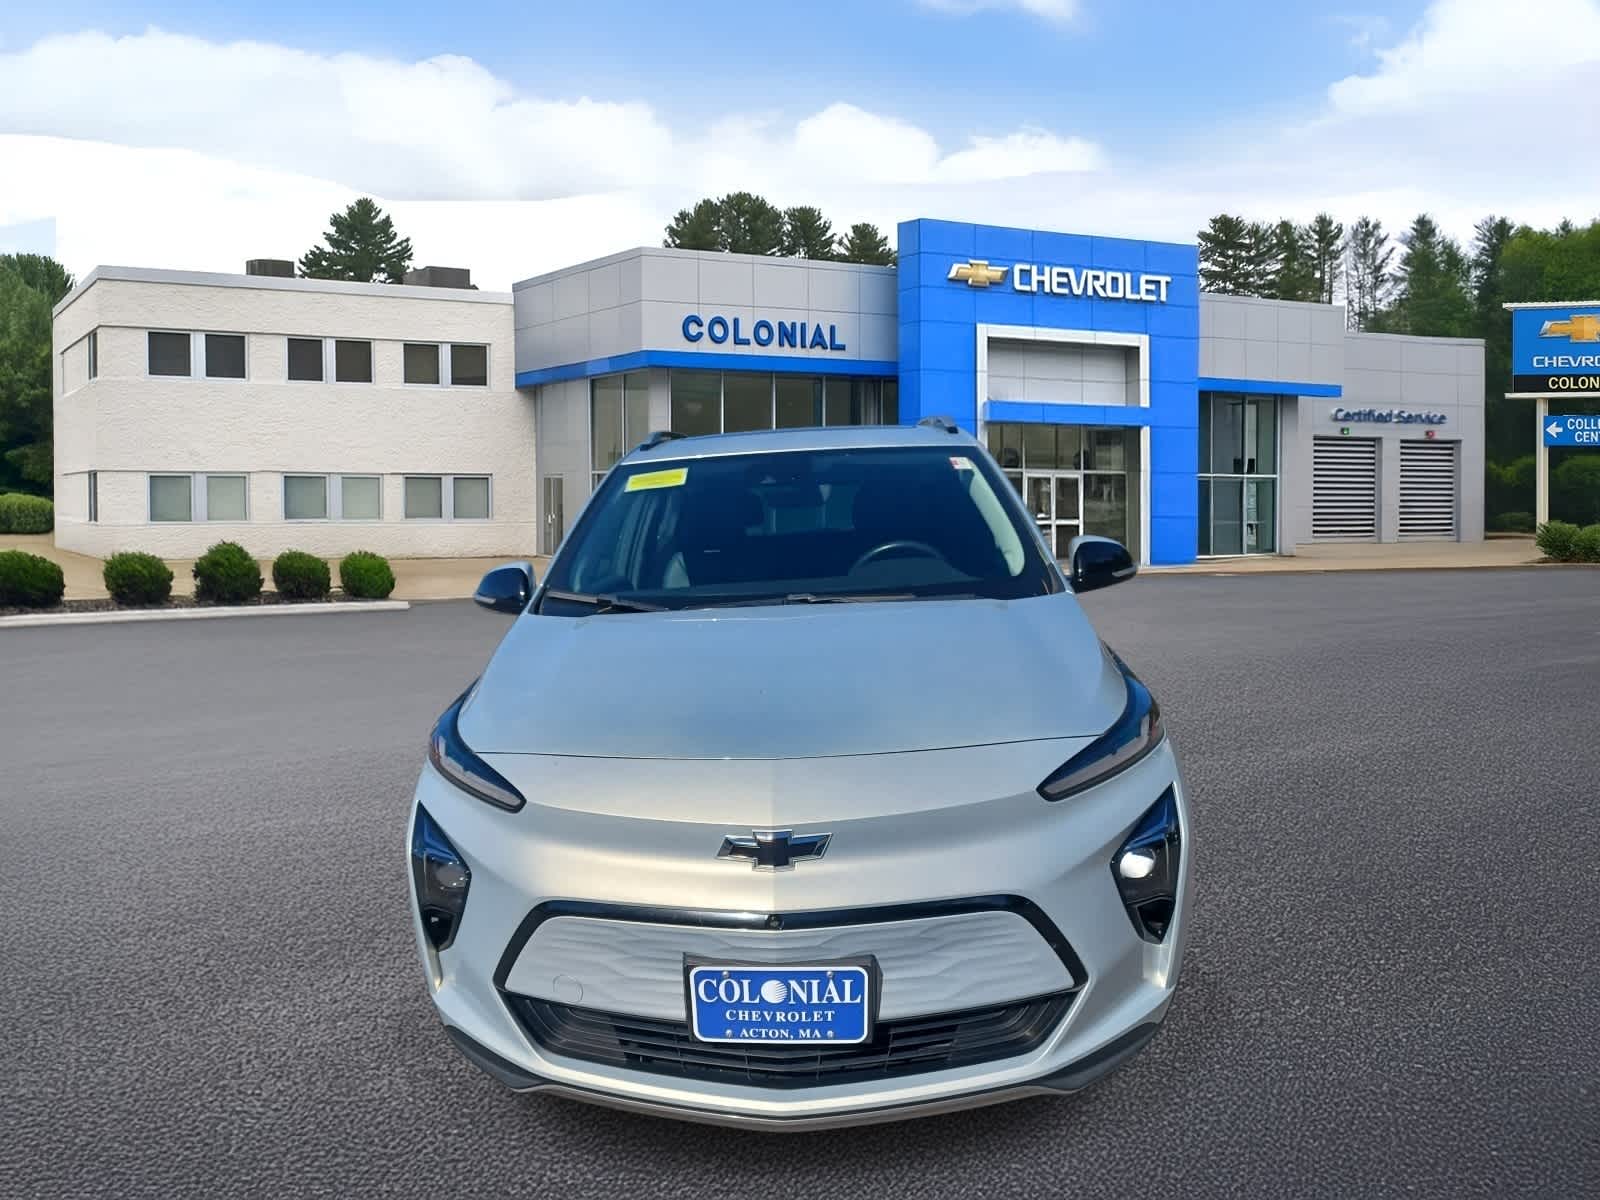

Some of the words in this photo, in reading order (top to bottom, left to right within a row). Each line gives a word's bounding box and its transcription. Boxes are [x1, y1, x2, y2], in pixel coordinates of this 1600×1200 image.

[1013, 262, 1171, 303] CHEVROLET
[682, 314, 846, 351] COLONIAL
[1332, 407, 1393, 424] Certified
[1394, 410, 1447, 425] Service
[697, 977, 861, 1005] COLONIAL
[725, 1009, 836, 1023] CHEVROLET
[739, 1028, 793, 1040] ACTON,
[799, 1028, 822, 1039] MA
